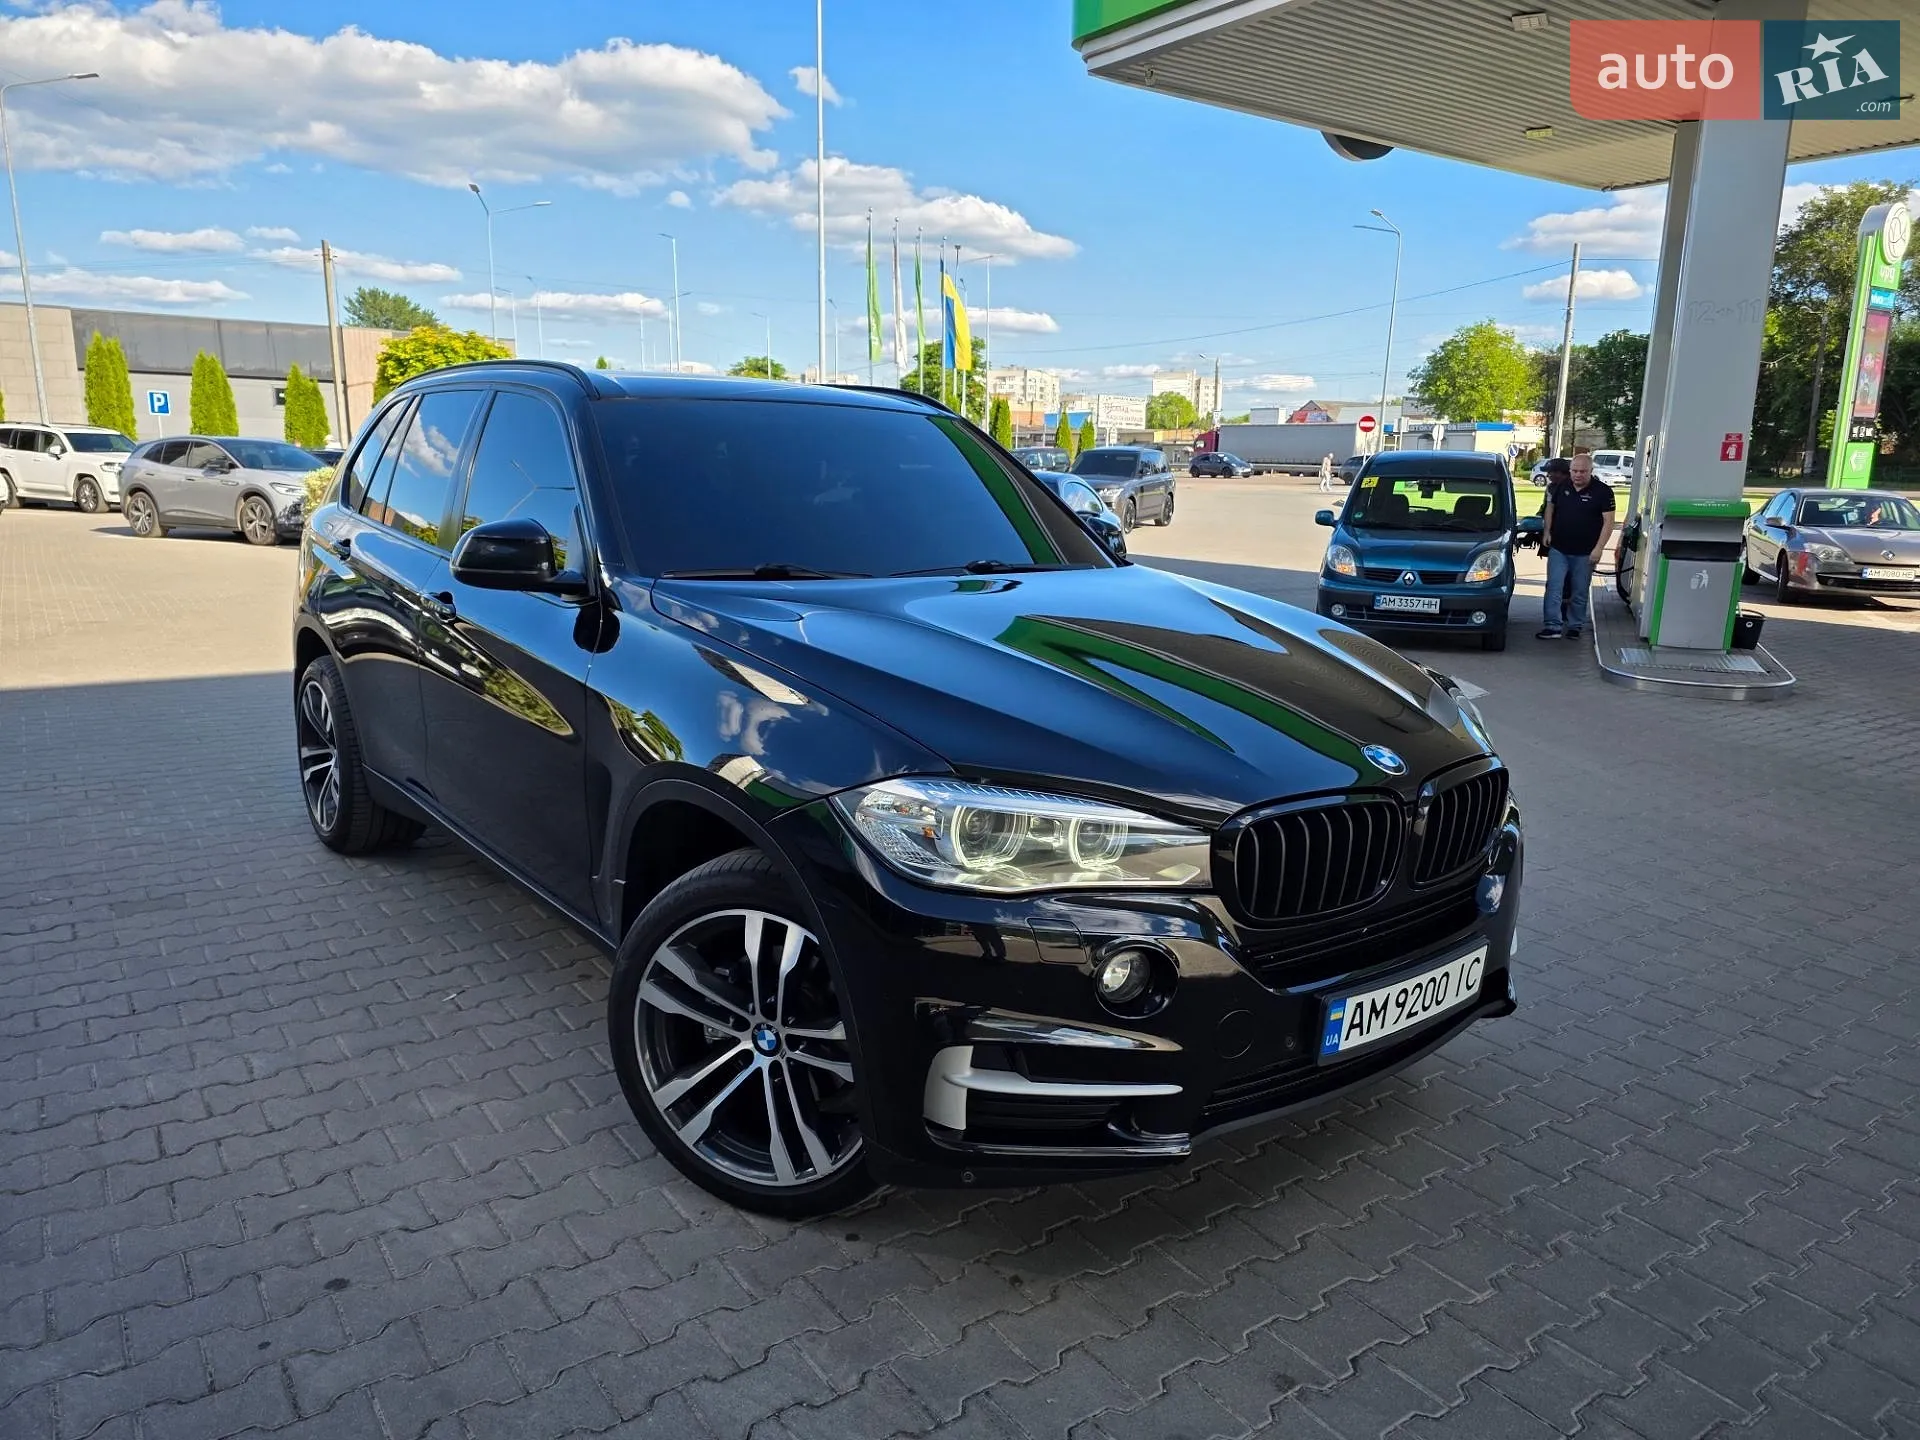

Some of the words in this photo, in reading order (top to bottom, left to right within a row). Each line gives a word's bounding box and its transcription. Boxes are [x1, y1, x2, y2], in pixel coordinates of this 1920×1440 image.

[153, 393, 165, 412] P
[1382, 597, 1396, 607] AM
[1397, 598, 1421, 608] 3357
[1423, 600, 1437, 610] HH
[1345, 992, 1391, 1041] AM
[1392, 971, 1450, 1025] 9200
[1456, 957, 1481, 997] IC
[1325, 1035, 1339, 1047] UA
